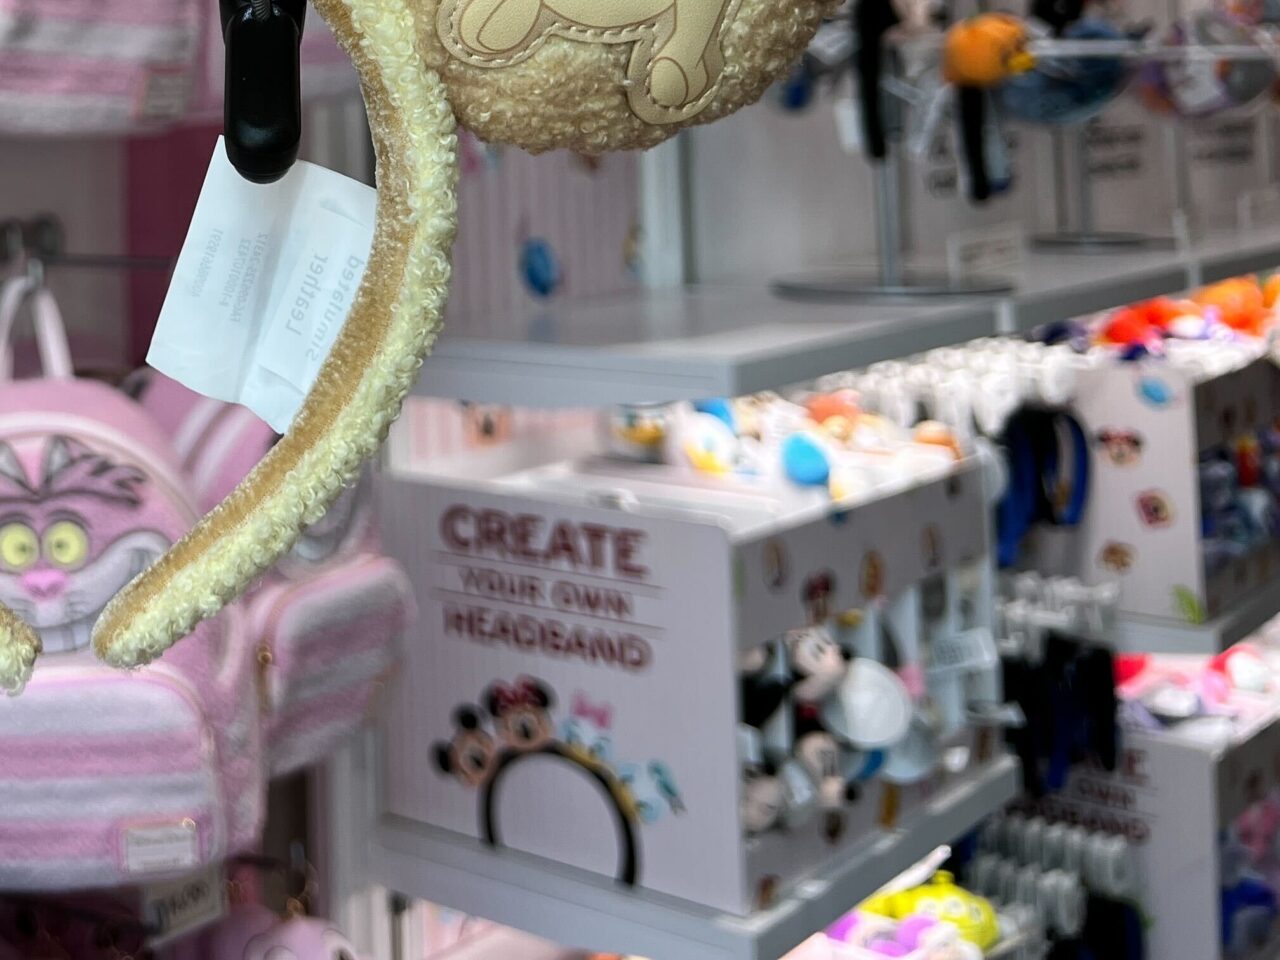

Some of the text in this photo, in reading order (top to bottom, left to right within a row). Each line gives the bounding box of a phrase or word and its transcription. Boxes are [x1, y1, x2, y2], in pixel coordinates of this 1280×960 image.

[440, 504, 650, 579] CREATE
[459, 566, 633, 618] YOUR OWN
[443, 606, 653, 671] HEADBAND
